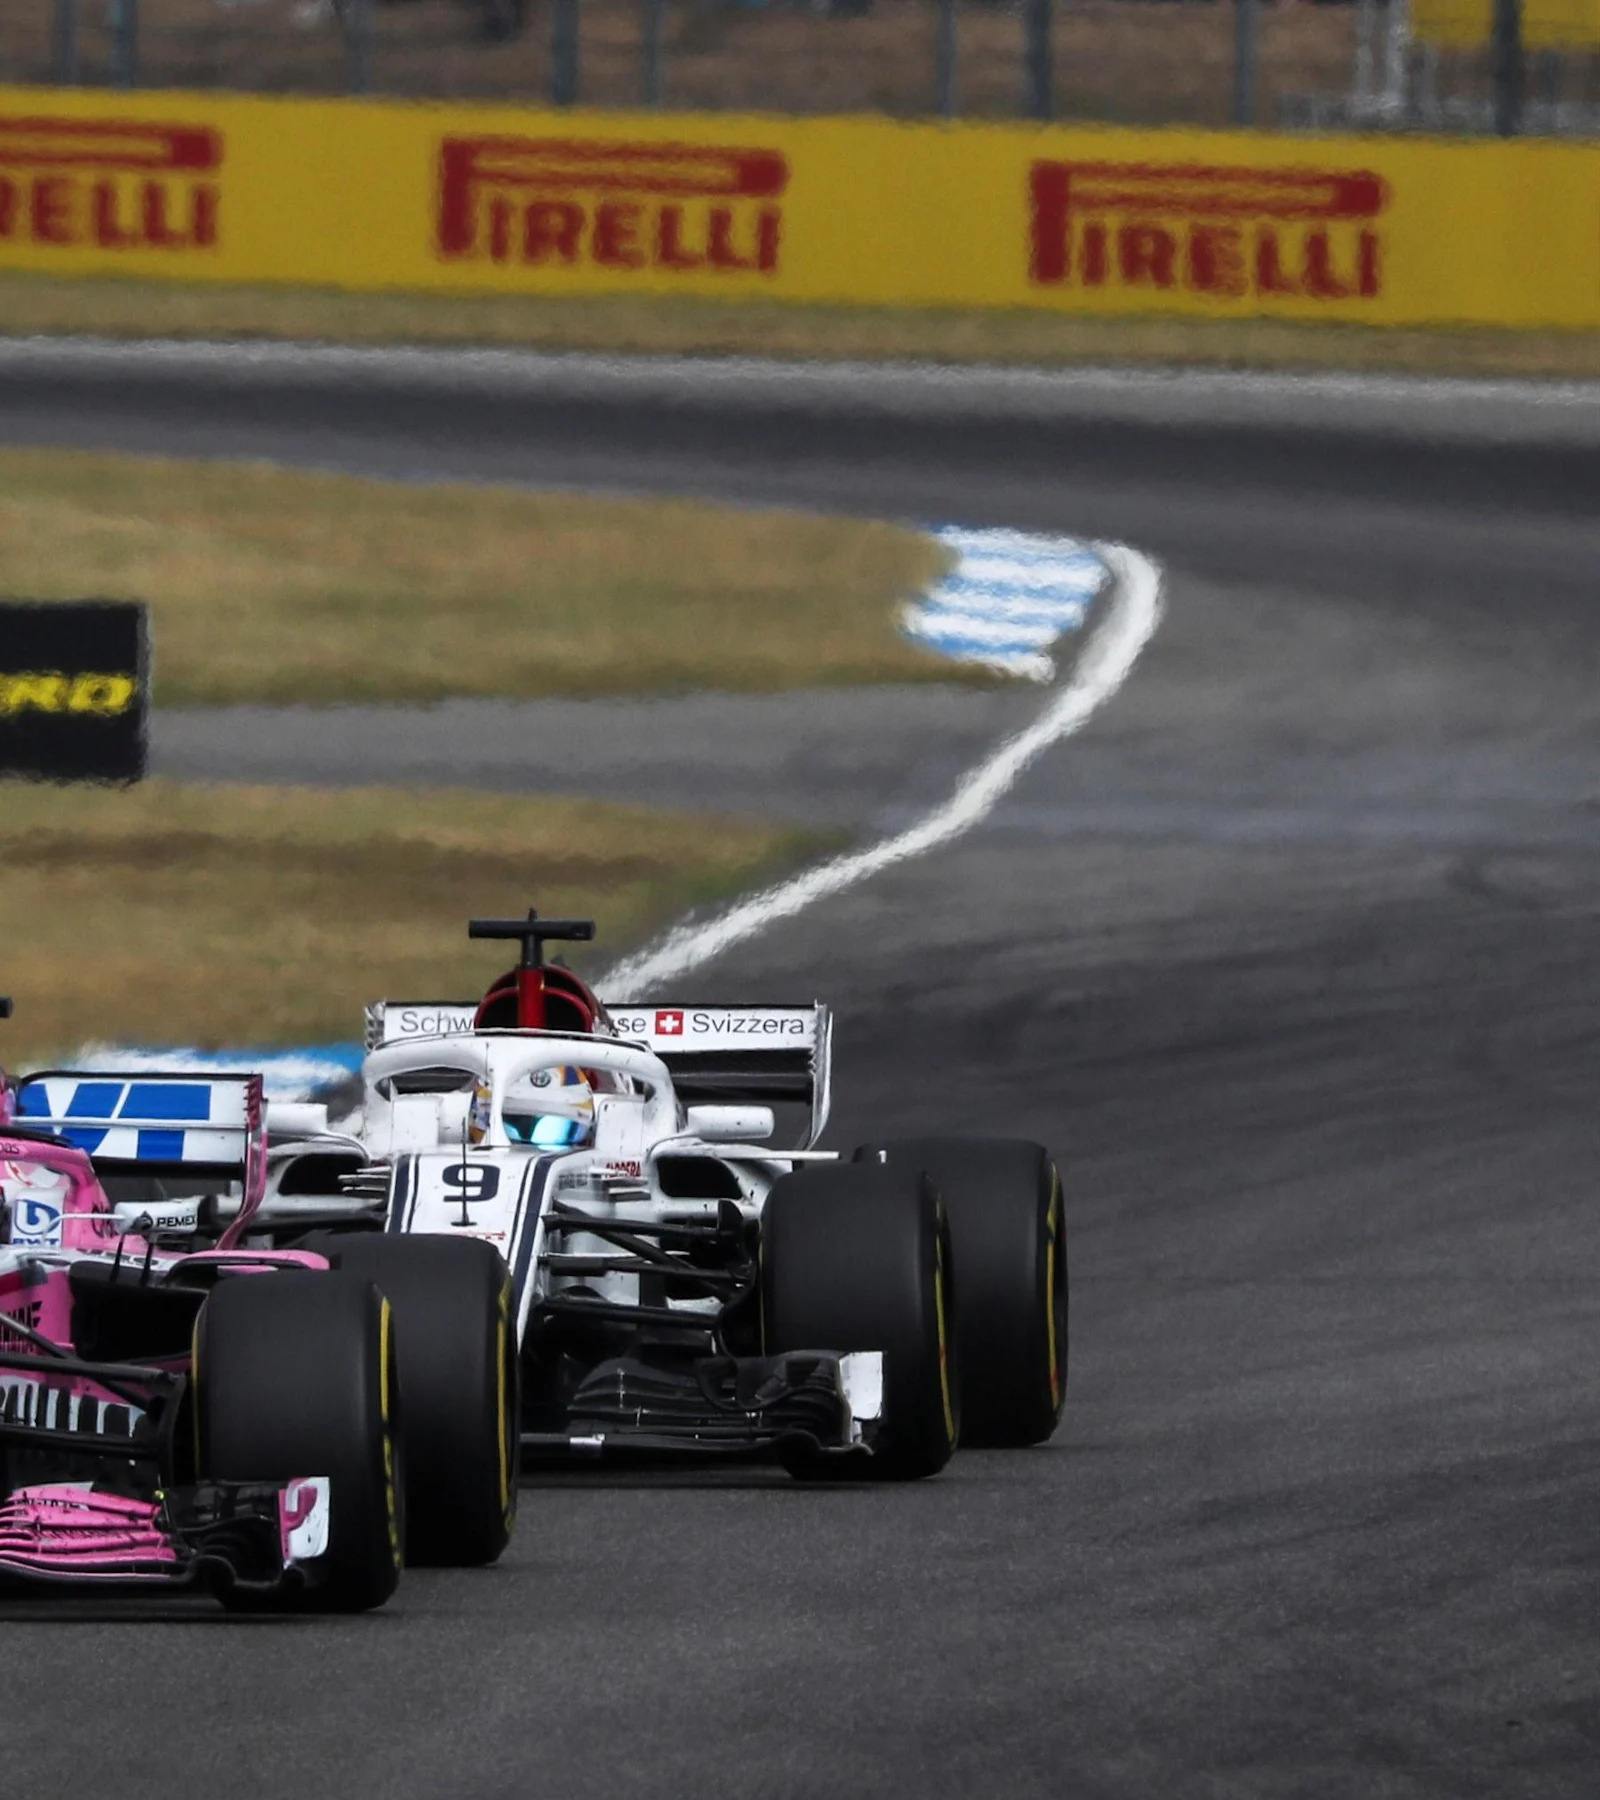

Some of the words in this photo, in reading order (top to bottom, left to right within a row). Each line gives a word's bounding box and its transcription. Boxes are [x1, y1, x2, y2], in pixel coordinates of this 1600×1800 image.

[437, 137, 788, 272] PIRELLI
[1029, 160, 1385, 297] PIRELLI
[400, 1011, 472, 1032] Schw
[692, 1013, 804, 1033] Svizzera
[442, 1163, 500, 1202] 9
